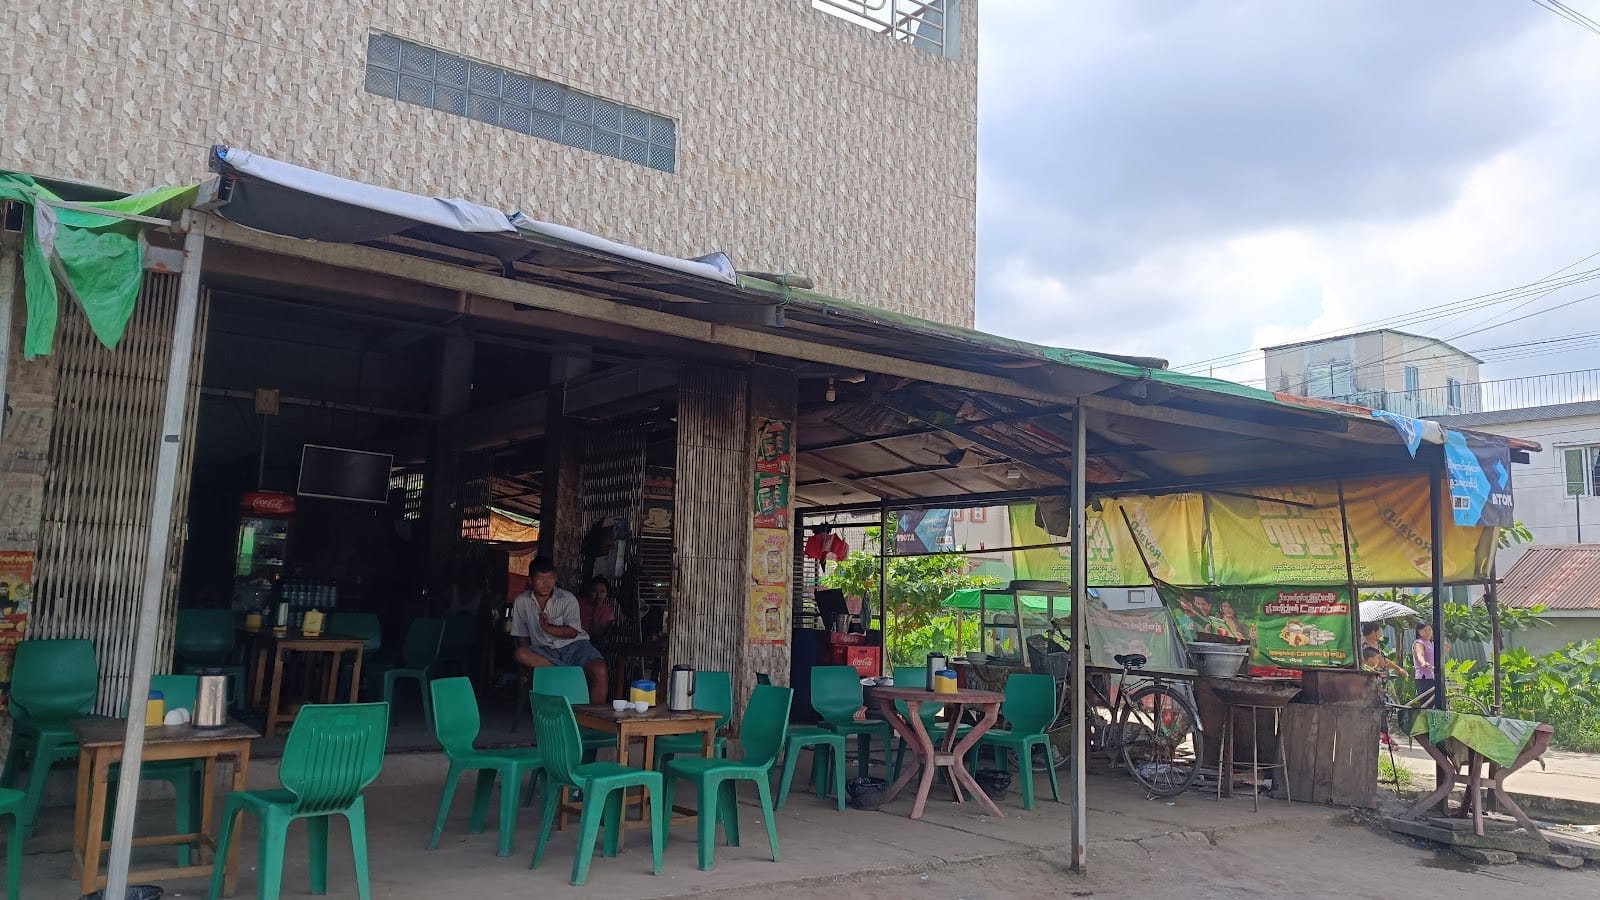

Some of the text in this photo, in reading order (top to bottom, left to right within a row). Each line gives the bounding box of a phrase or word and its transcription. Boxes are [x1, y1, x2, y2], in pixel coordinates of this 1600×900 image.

[252, 497, 284, 509] Coca-Cola
[1492, 493, 1513, 507] ATOM
[1299, 603, 1347, 614] Carabao
[852, 656, 873, 667] Coca-Cola
